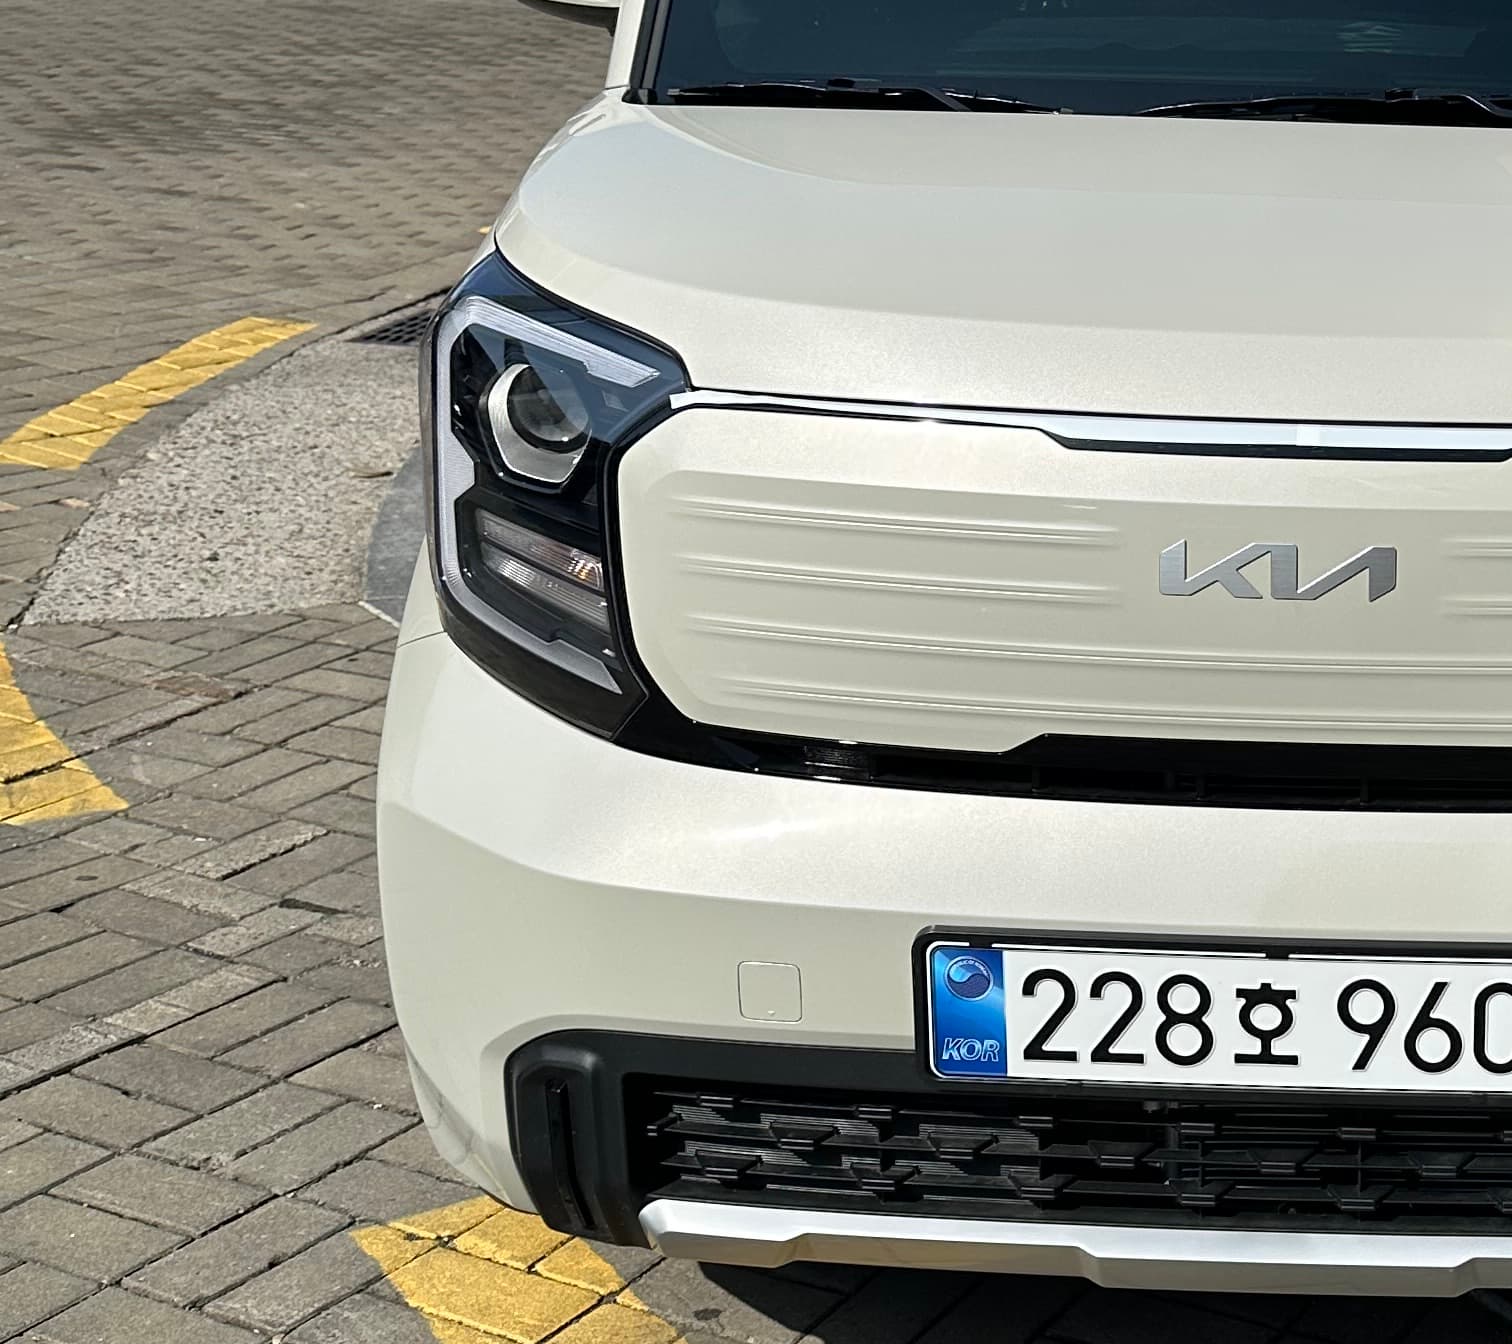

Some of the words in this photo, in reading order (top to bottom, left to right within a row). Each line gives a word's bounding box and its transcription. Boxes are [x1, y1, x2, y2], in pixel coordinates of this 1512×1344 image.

[1159, 538, 1398, 603] KIA
[941, 1037, 1001, 1062] KOR
[1020, 967, 1300, 1068] 228호
